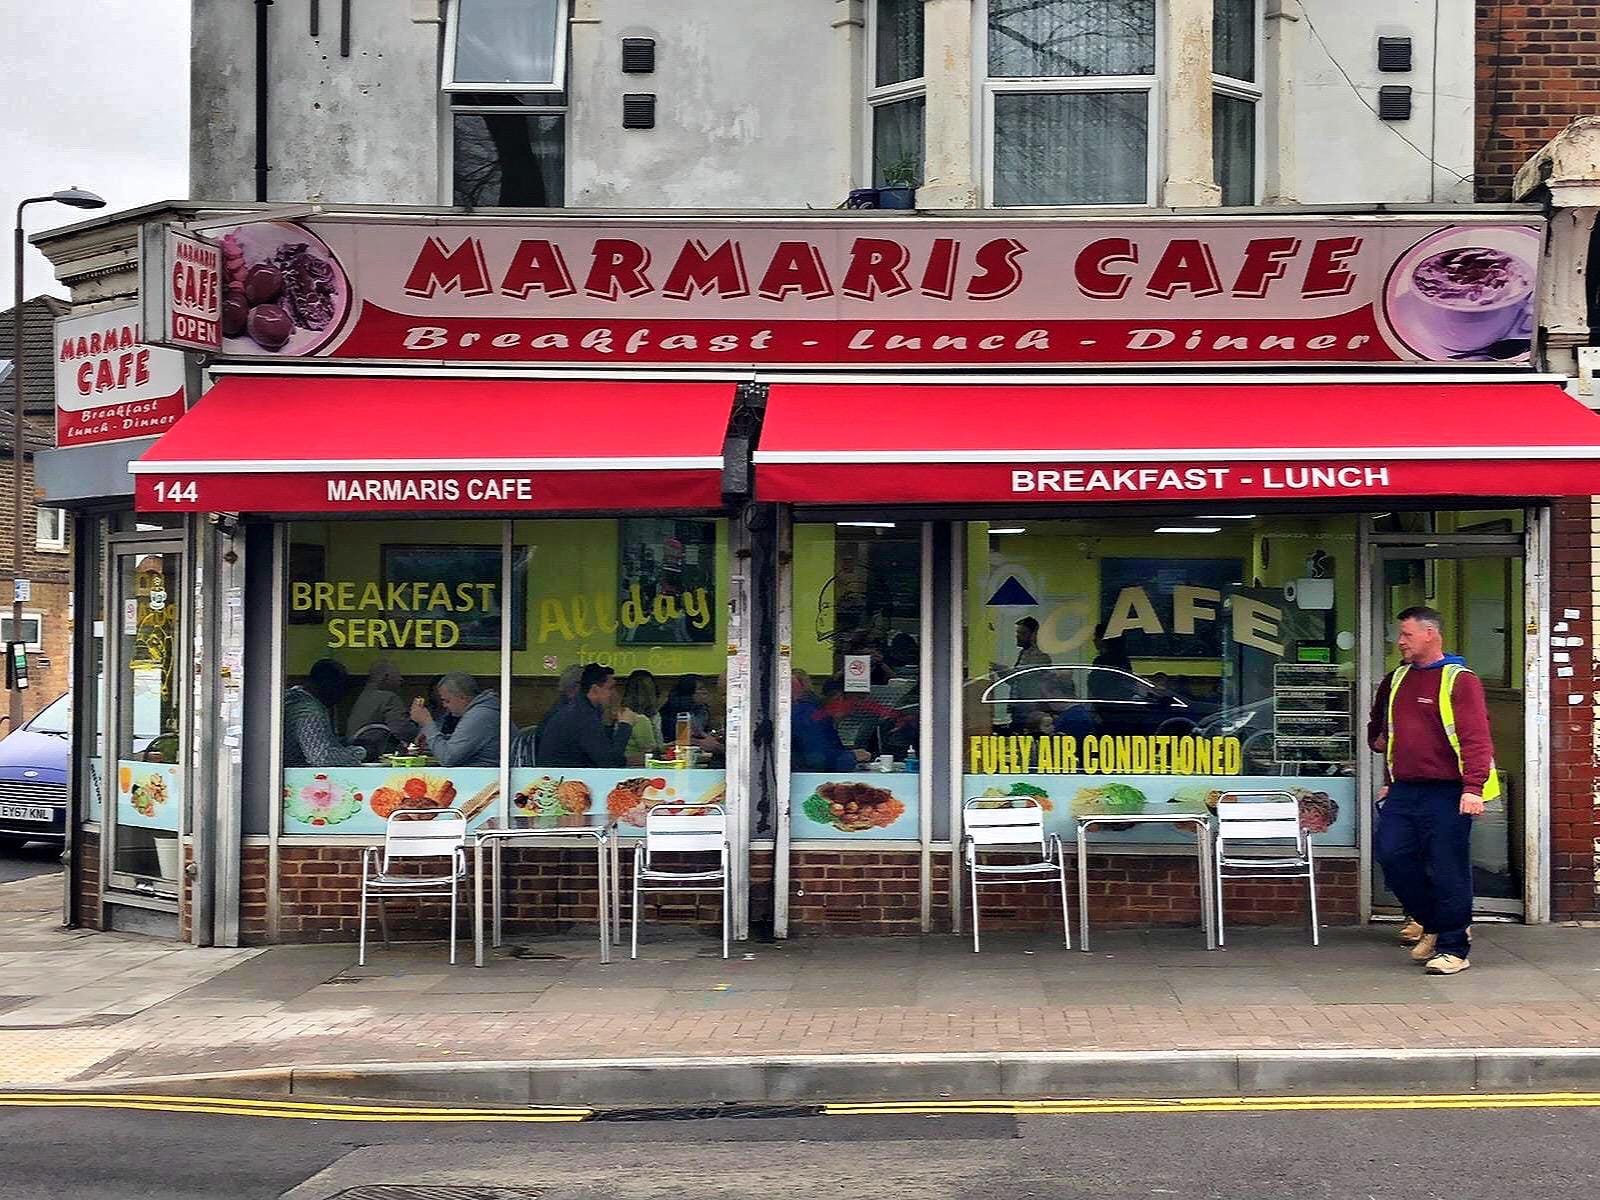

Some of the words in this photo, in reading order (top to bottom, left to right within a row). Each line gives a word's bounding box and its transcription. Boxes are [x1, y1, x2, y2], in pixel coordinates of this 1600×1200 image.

[404, 236, 1028, 301] MARMARIS
[1073, 236, 1363, 301] CAFE
[173, 260, 218, 313] CAFE
[60, 323, 139, 362] MARMA
[176, 316, 217, 344] OPEN
[402, 326, 773, 355] Breakfast
[847, 328, 1050, 351] Lunch
[1125, 328, 1371, 351] Dinner
[77, 349, 150, 396] CAFE
[81, 400, 158, 422] Breakfast
[67, 422, 109, 438] Lunch
[122, 415, 175, 430] Dinner
[153, 481, 198, 502] 144
[327, 479, 460, 501] MARMARIS
[466, 478, 533, 500] CAFE
[1011, 468, 1230, 493] BREAKFAST
[1263, 467, 1389, 488] LUNCH
[292, 582, 496, 612] BREAKFAST
[538, 591, 618, 644] All
[622, 582, 711, 629] day
[1037, 583, 1285, 657] CAFE
[328, 618, 460, 648] SERVED
[970, 735, 1032, 774] FULLY
[1037, 735, 1077, 774] AIR
[1082, 734, 1242, 776] CONDITIONED
[3, 806, 28, 818] EY67
